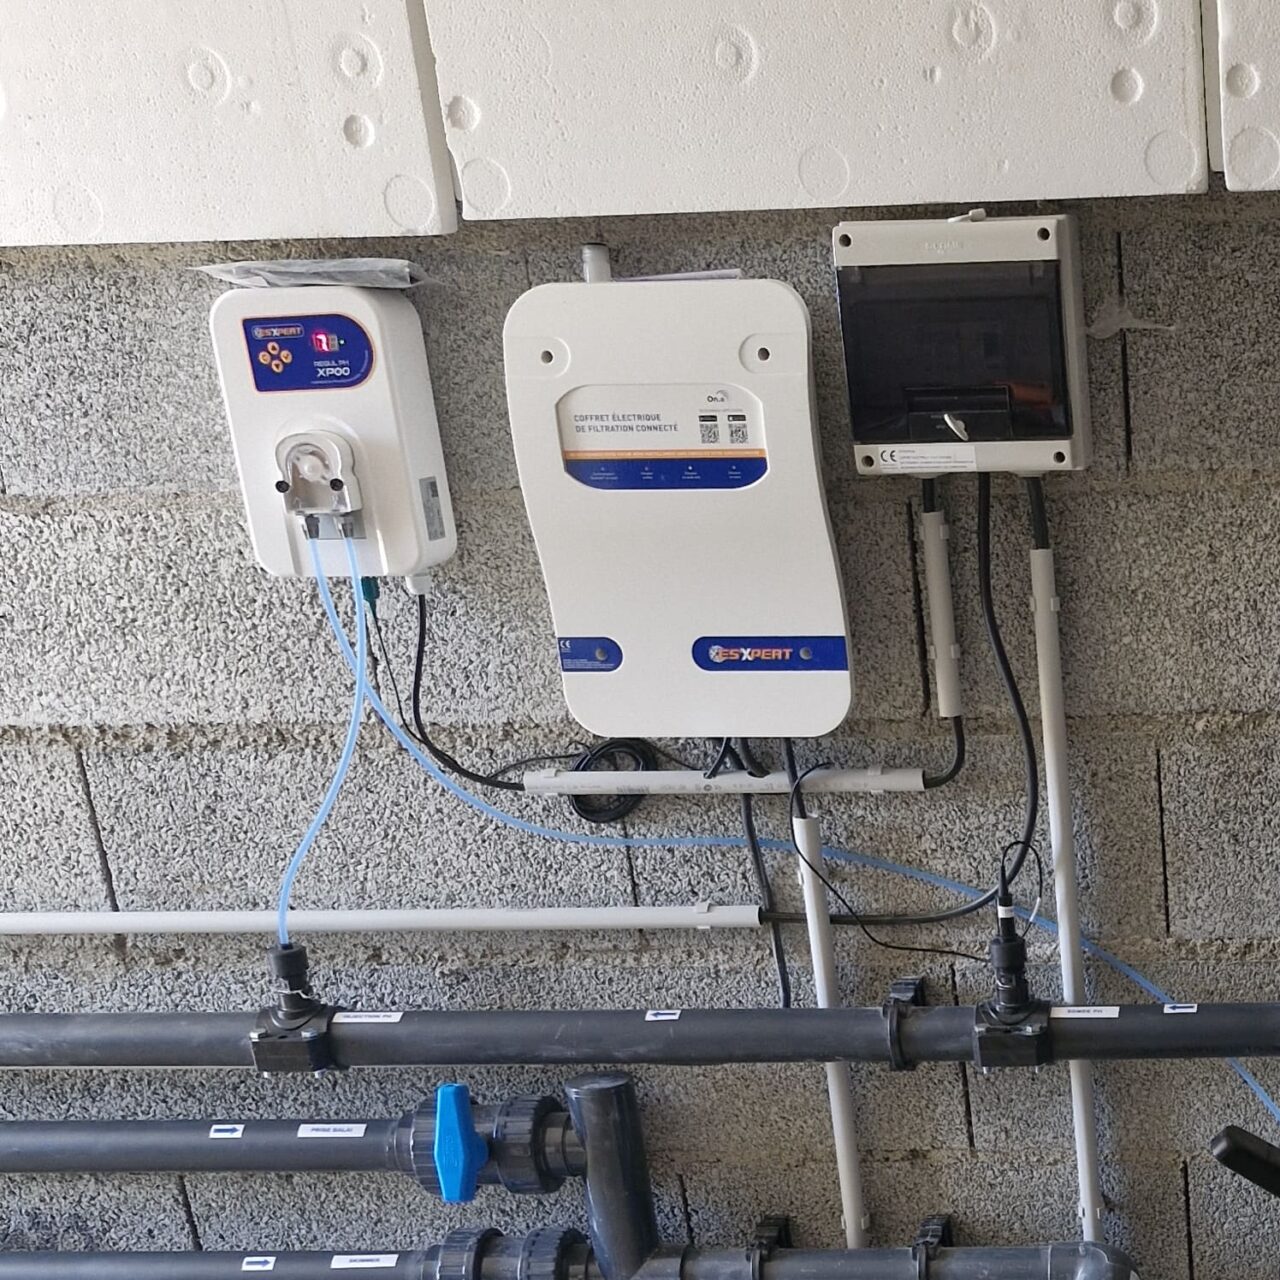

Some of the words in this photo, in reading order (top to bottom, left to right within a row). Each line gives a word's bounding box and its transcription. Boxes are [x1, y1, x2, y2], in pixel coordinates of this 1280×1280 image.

[574, 414, 609, 422] COFFRET
[612, 411, 661, 421] ÉLECTRIQUE
[588, 424, 634, 432] FILTRATION
[636, 421, 679, 431] CONNECTÉ
